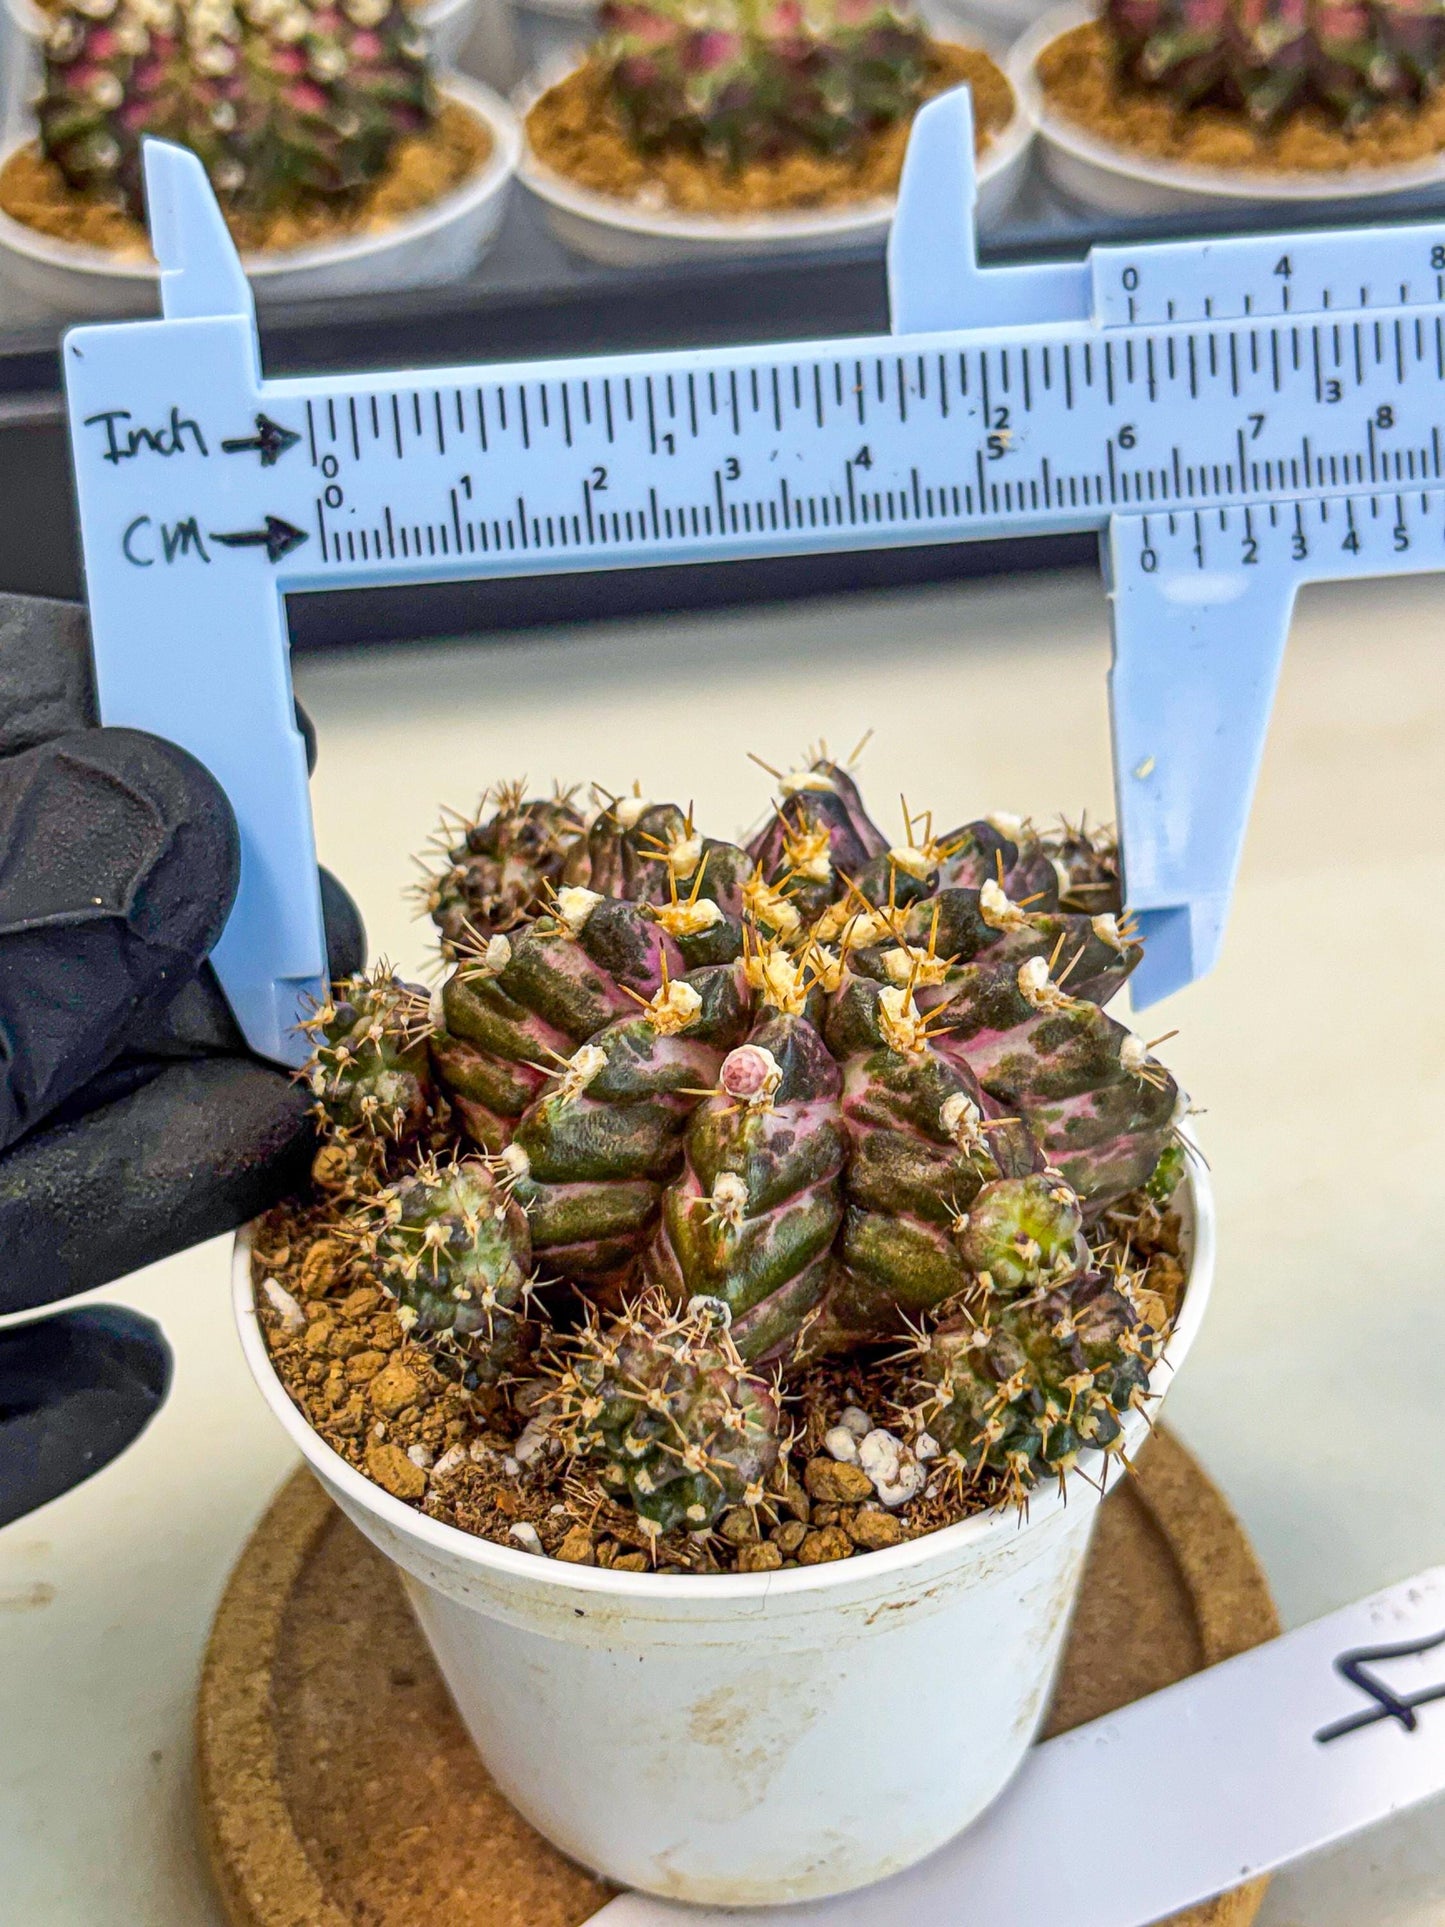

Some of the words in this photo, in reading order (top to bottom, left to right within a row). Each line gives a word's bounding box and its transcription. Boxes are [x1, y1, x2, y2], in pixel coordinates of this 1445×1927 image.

[1122, 267, 1138, 291] 0
[1274, 255, 1292, 280] 4
[1431, 245, 1445, 270] 8
[84, 407, 209, 464] Inch
[321, 455, 339, 478] 0
[663, 433, 675, 455] 1
[994, 407, 1009, 429] 2
[1326, 380, 1341, 402] 3
[325, 485, 343, 508] 0
[461, 475, 472, 499] 1
[593, 467, 608, 490] 2
[726, 458, 741, 480] 3
[855, 446, 872, 470] 4
[987, 436, 1004, 460] 5
[1118, 425, 1136, 449] 6
[1249, 414, 1264, 440] 7
[1376, 405, 1393, 430] 8
[1141, 549, 1156, 572] 0
[1193, 544, 1203, 568] 1
[1241, 539, 1257, 564] 2
[1292, 535, 1307, 560] 3
[1342, 530, 1359, 555] 4
[1393, 526, 1409, 551] 5
